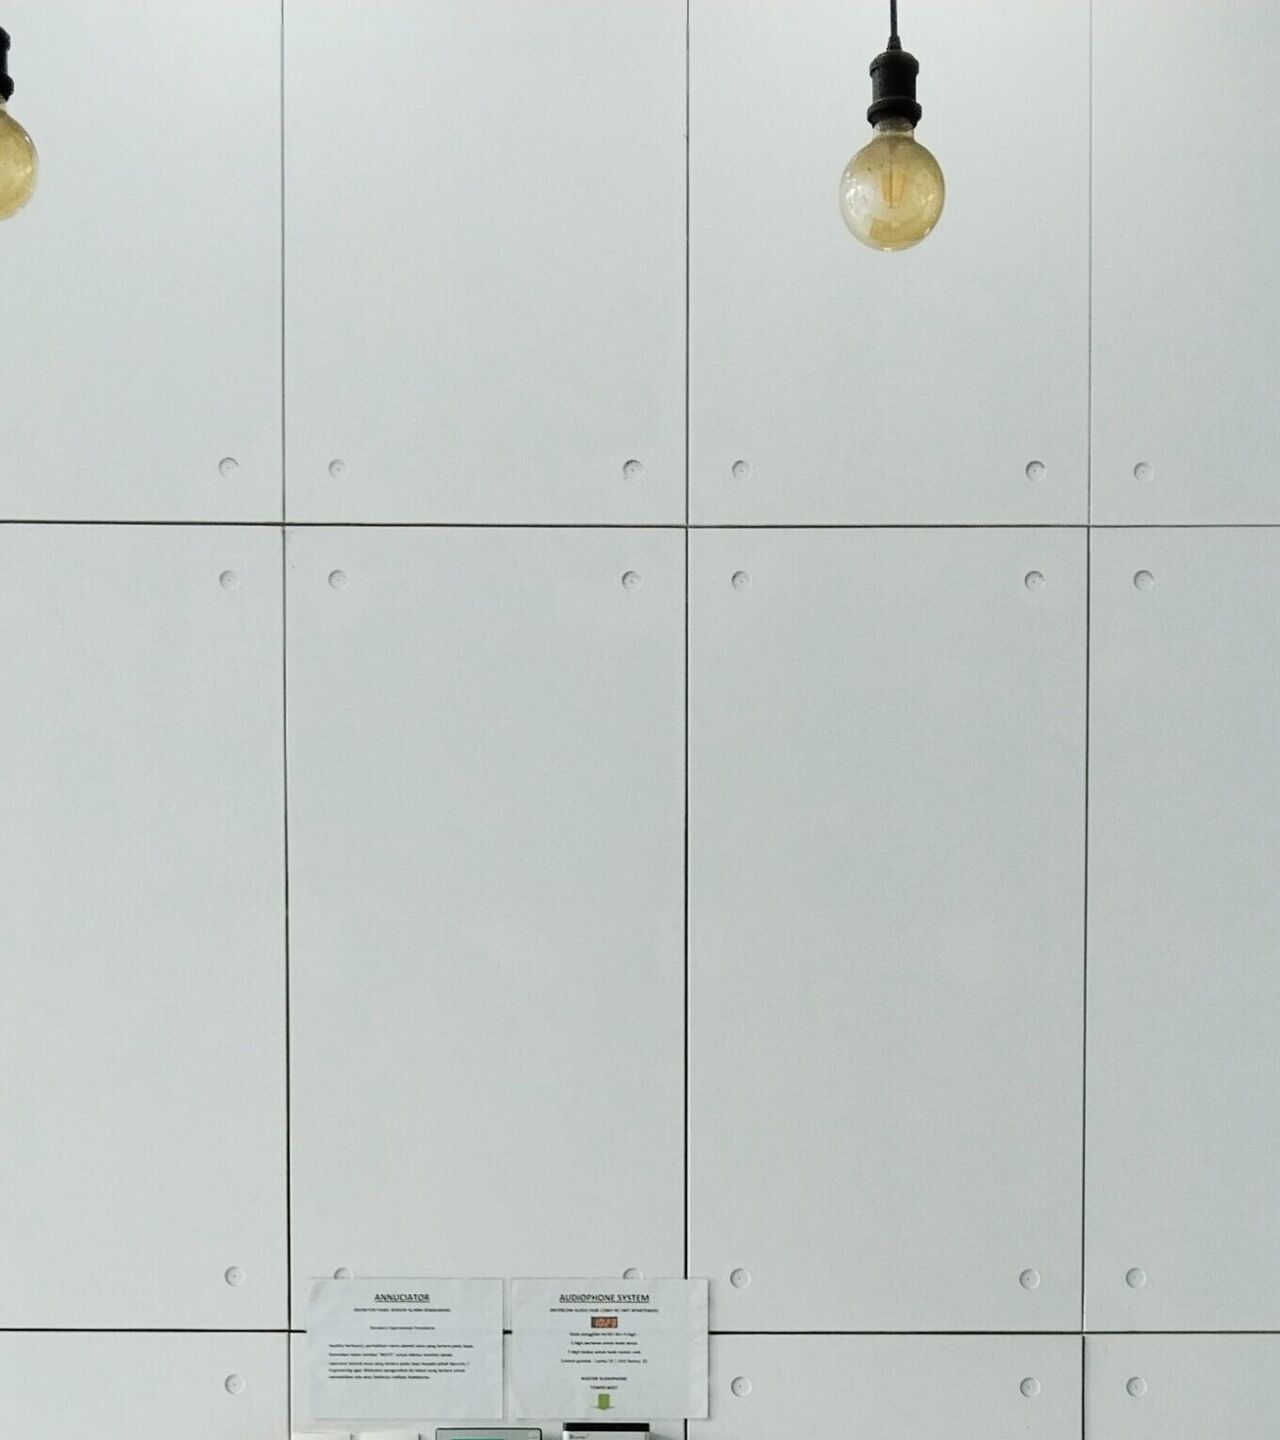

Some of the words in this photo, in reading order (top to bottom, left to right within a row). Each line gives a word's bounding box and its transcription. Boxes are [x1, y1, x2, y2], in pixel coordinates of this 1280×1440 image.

[374, 1293, 431, 1303] ANNUCIATOR
[559, 1293, 616, 1303] AUDIOPHONE
[617, 1293, 650, 1303] SYSTEM
